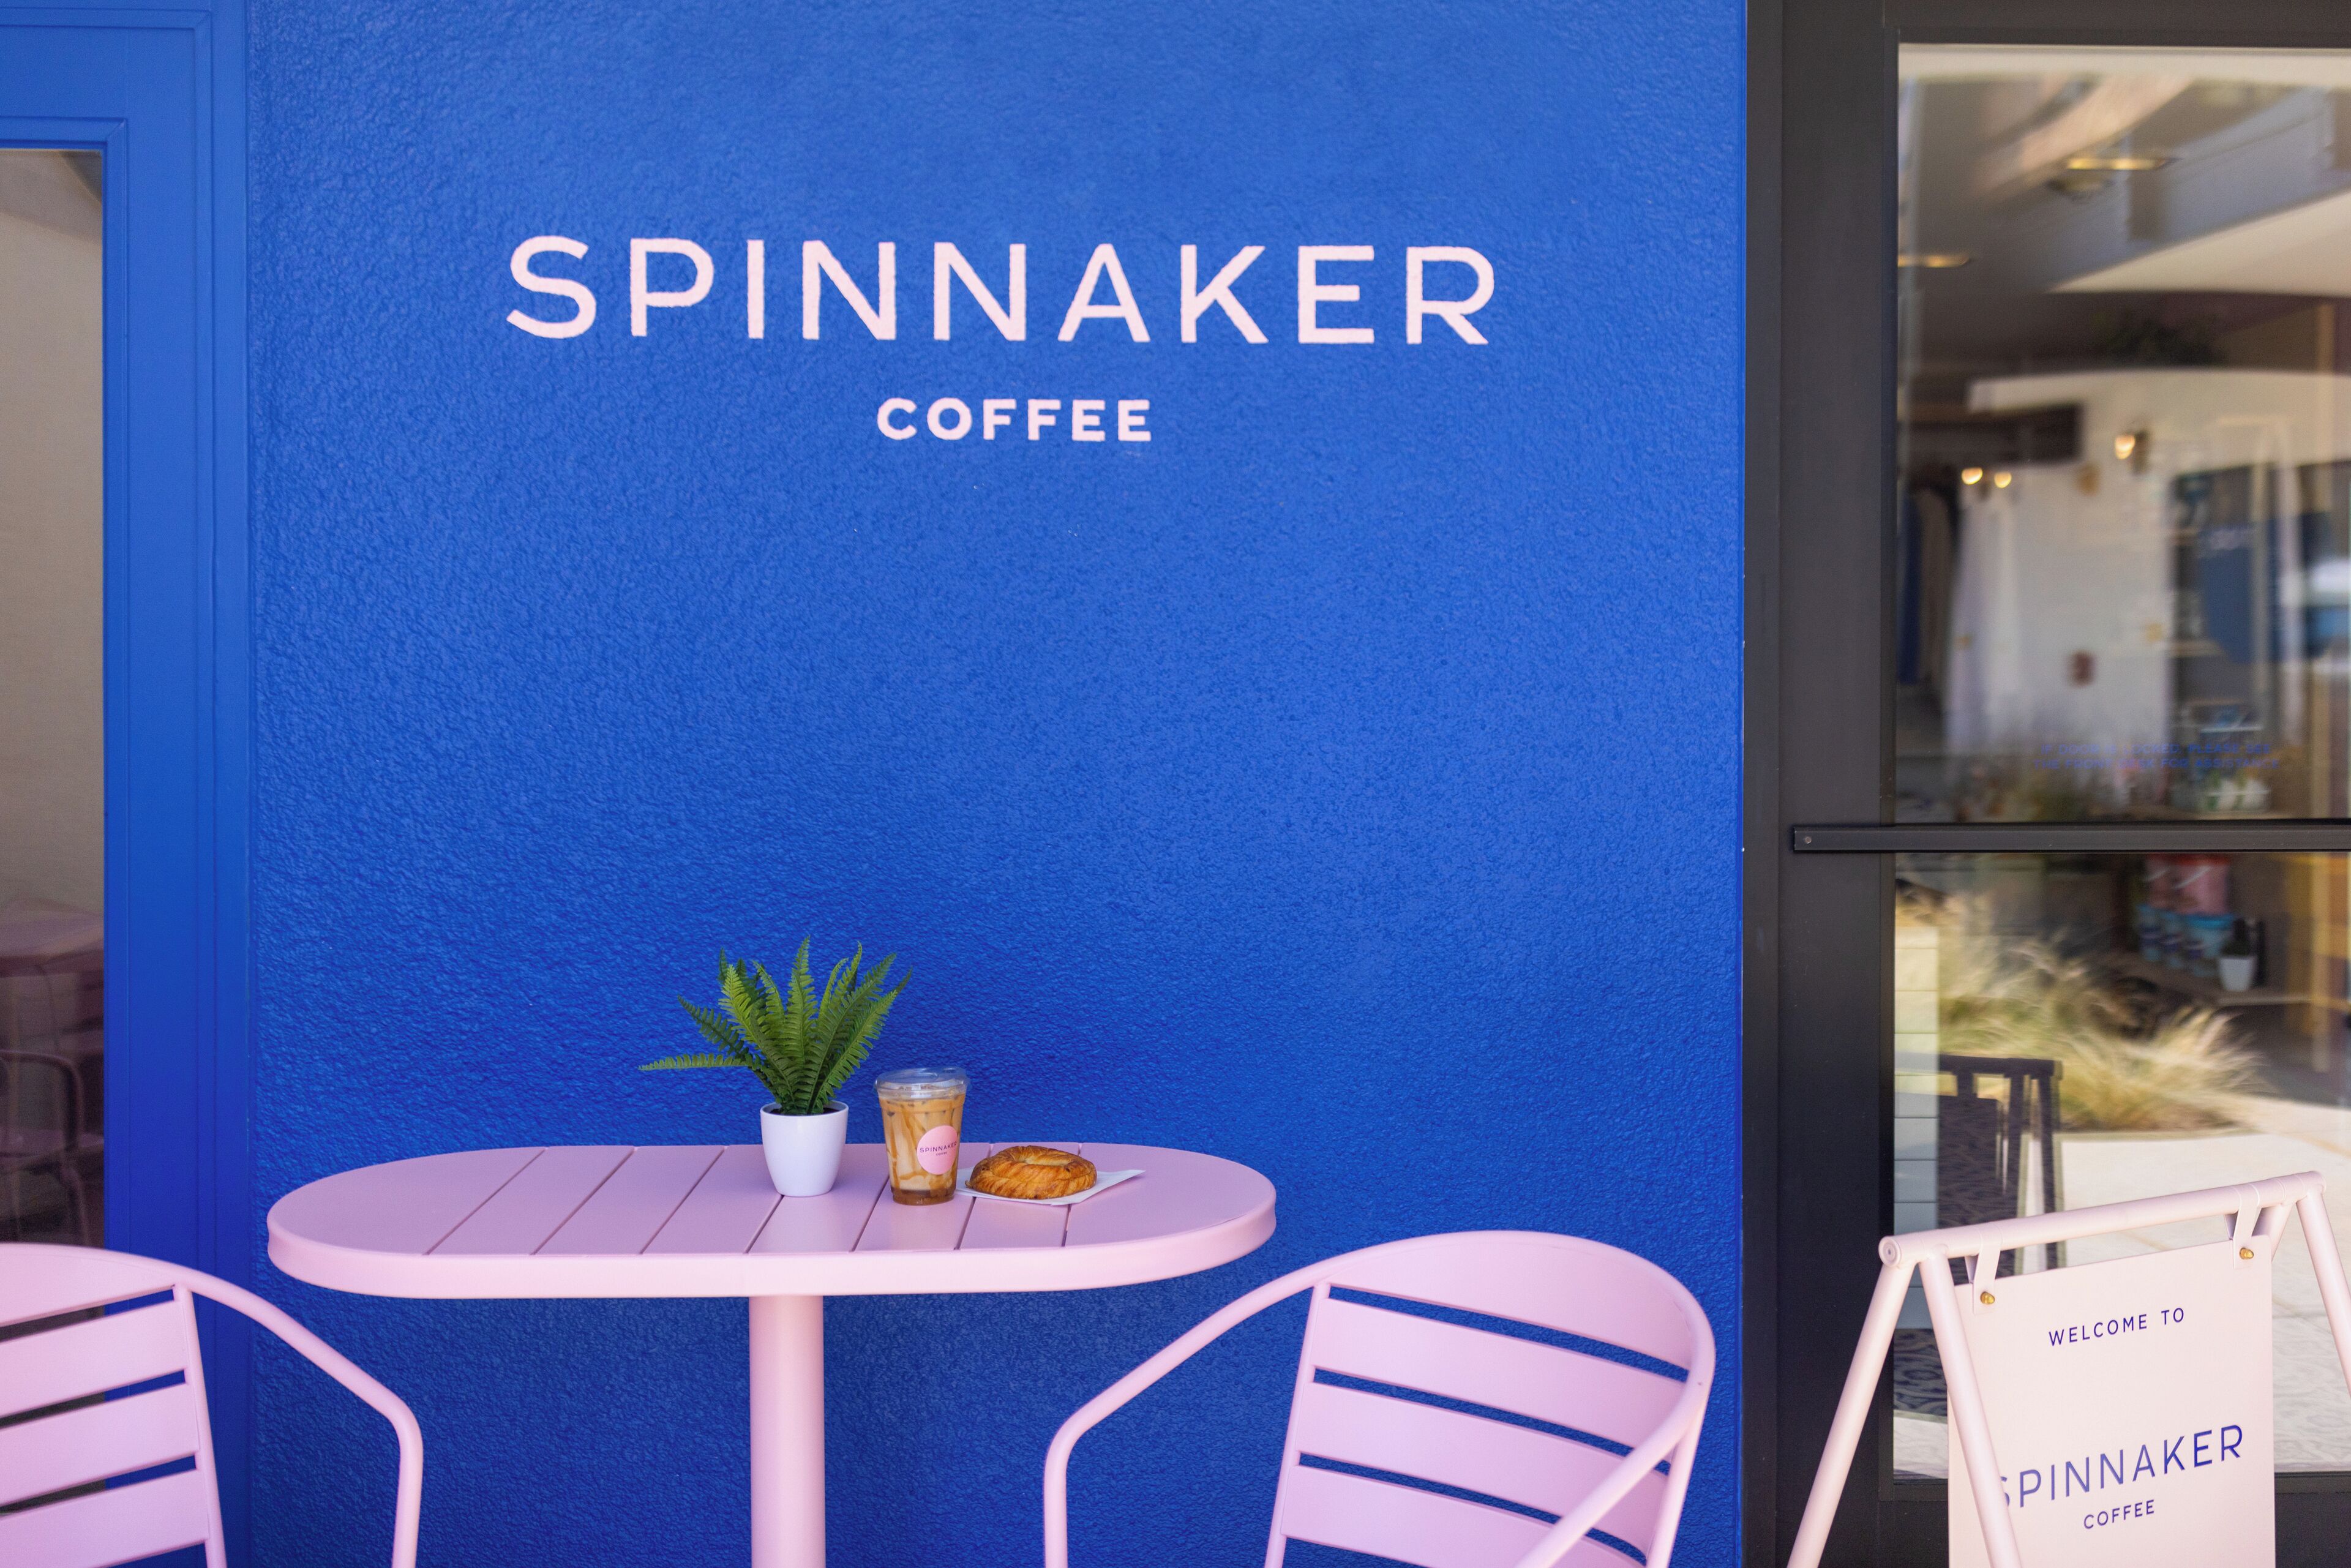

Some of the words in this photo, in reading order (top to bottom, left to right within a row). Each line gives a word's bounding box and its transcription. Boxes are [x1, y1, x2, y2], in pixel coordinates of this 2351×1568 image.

[506, 234, 1496, 345] SPINNAKER
[876, 396, 1152, 443] COFFEE
[2161, 758, 2189, 769] FOR
[2188, 743, 2240, 754] PLEASE
[2246, 743, 2271, 754] SEE
[920, 1141, 957, 1153] SPINNAKER
[2048, 1313, 2148, 1346] WELCOME
[2161, 1307, 2185, 1326] TO
[2083, 1499, 2155, 1530] COFFEE
